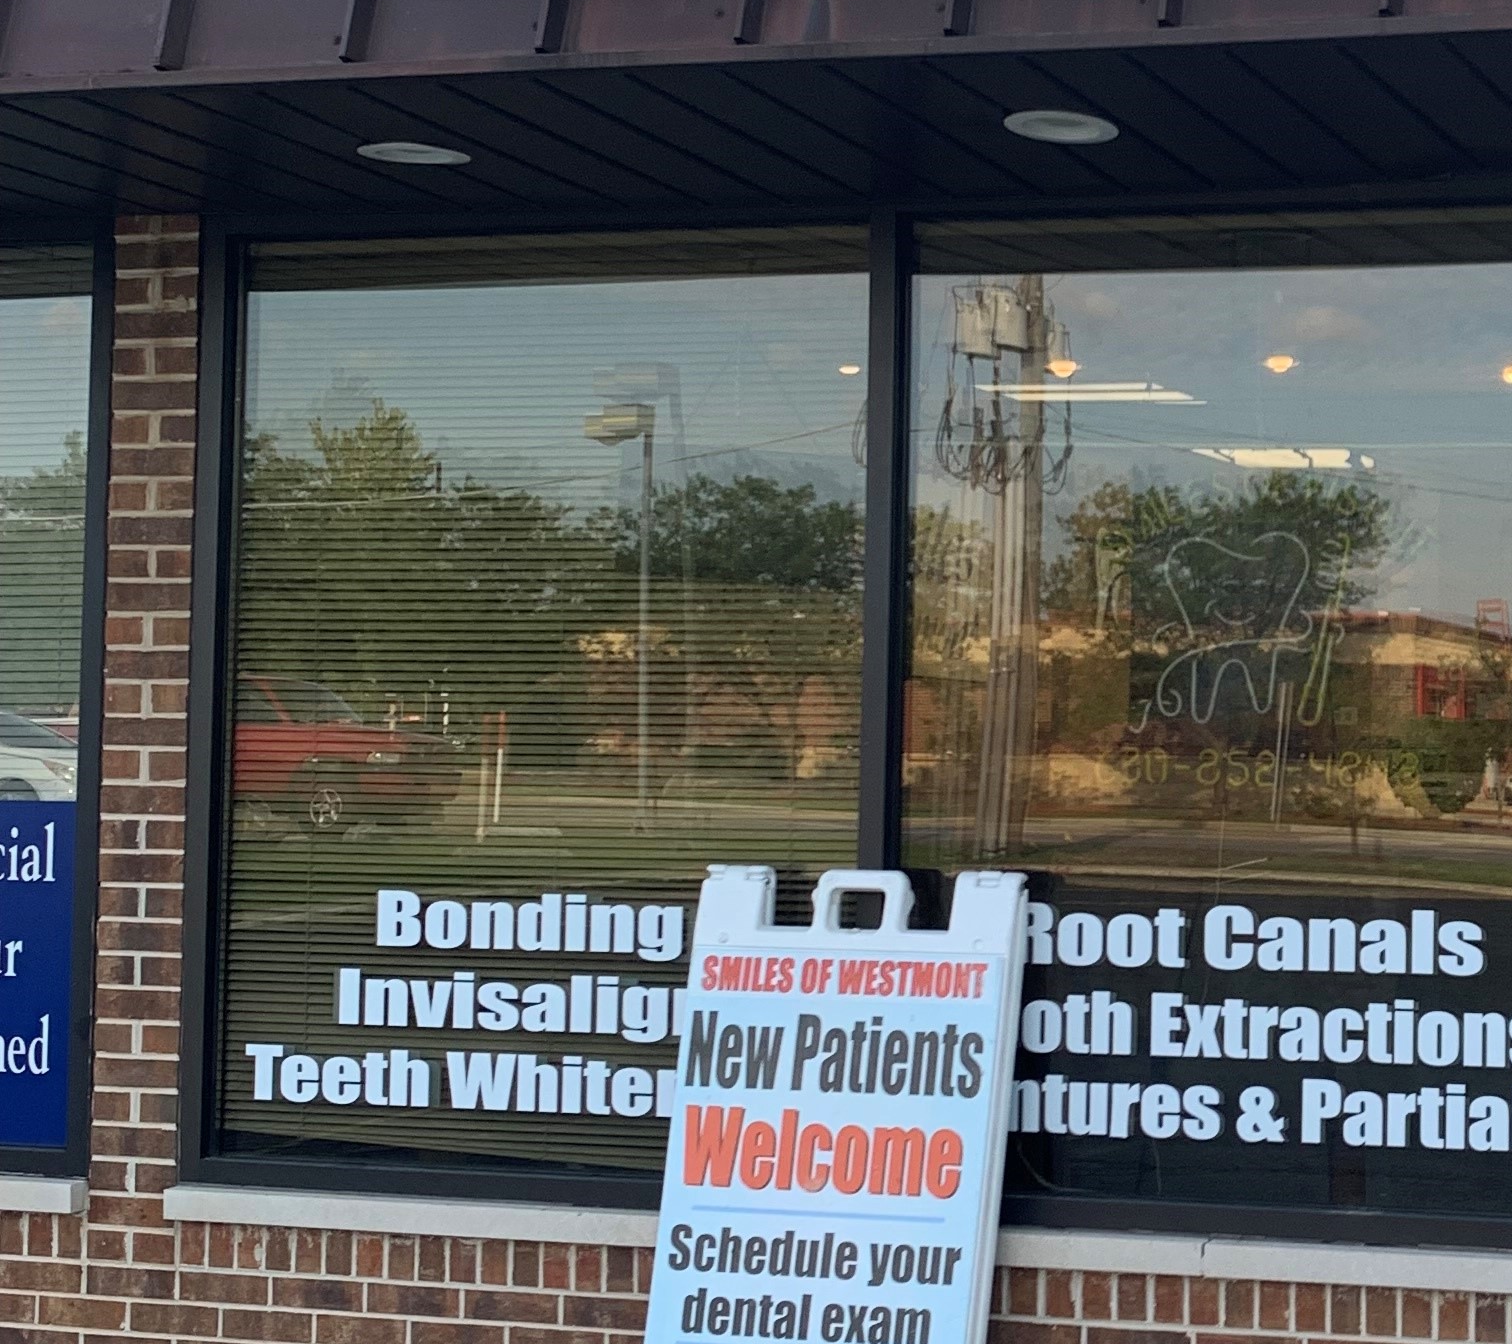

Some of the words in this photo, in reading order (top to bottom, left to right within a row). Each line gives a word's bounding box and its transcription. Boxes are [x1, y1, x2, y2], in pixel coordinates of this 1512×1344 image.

[0, 821, 56, 883] ial
[375, 888, 685, 962] Bonding
[1203, 904, 1486, 976] Canals
[0, 938, 23, 978] r
[701, 954, 795, 994] SMILES
[801, 958, 833, 995] OF
[838, 959, 988, 1000] WESTMONT
[244, 1042, 430, 1108] Teeth
[685, 1009, 785, 1090] New
[791, 1013, 985, 1100] Patients
[1236, 1085, 1286, 1143] &
[683, 1104, 965, 1201] Welcome
[667, 1223, 858, 1281] Schedule
[866, 1243, 963, 1287] your
[680, 1287, 812, 1342] dental
